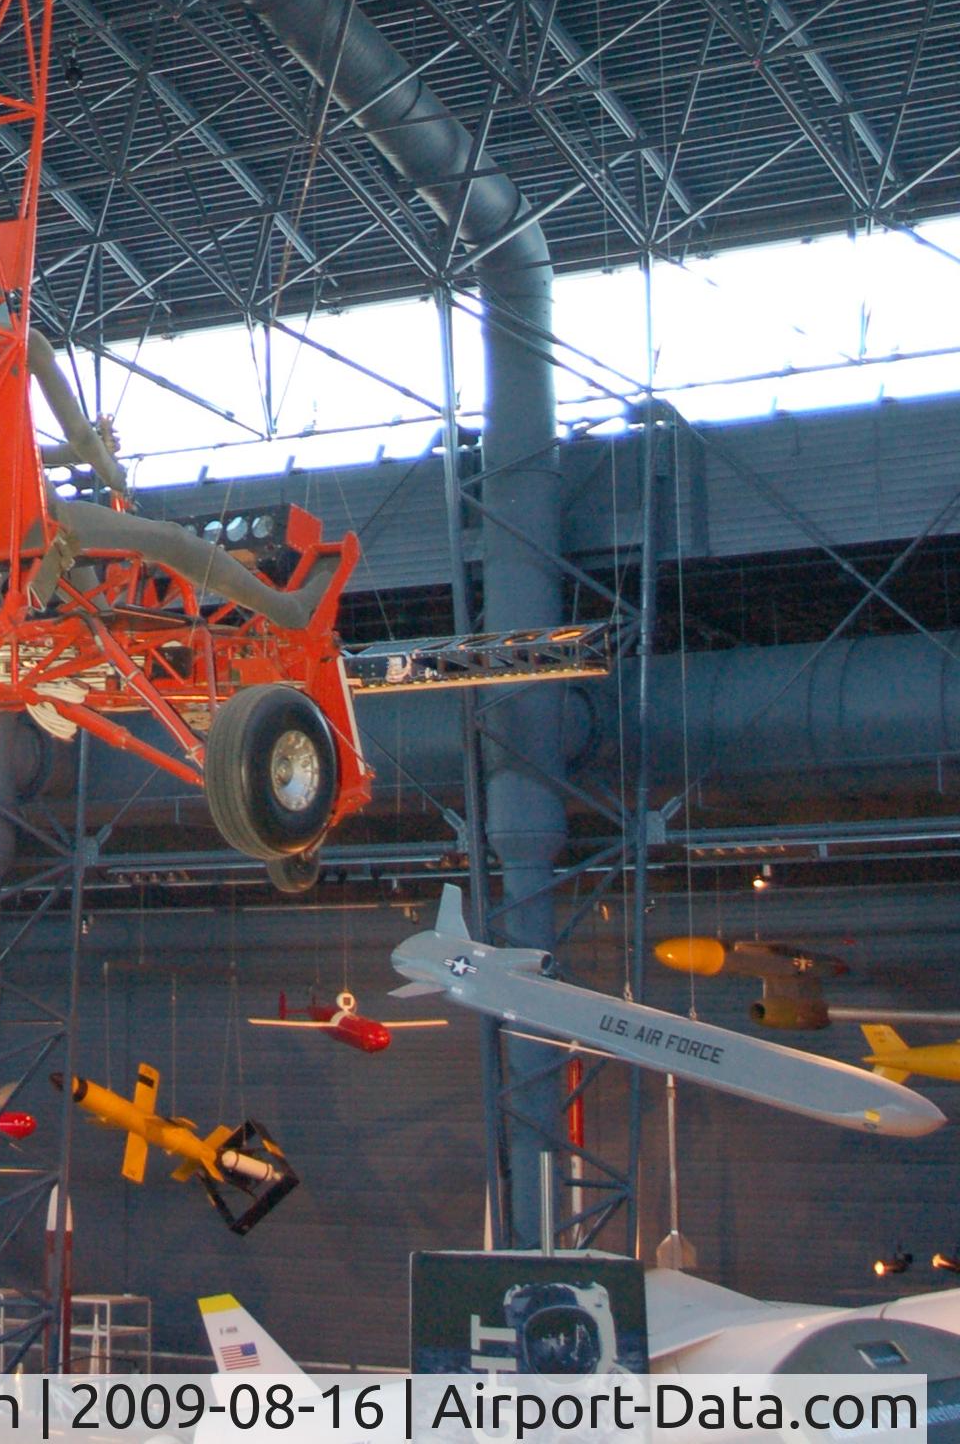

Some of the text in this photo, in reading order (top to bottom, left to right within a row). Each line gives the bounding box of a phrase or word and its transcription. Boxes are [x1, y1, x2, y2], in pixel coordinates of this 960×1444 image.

[599, 1014, 725, 1064] U.S. AIR FORCE
